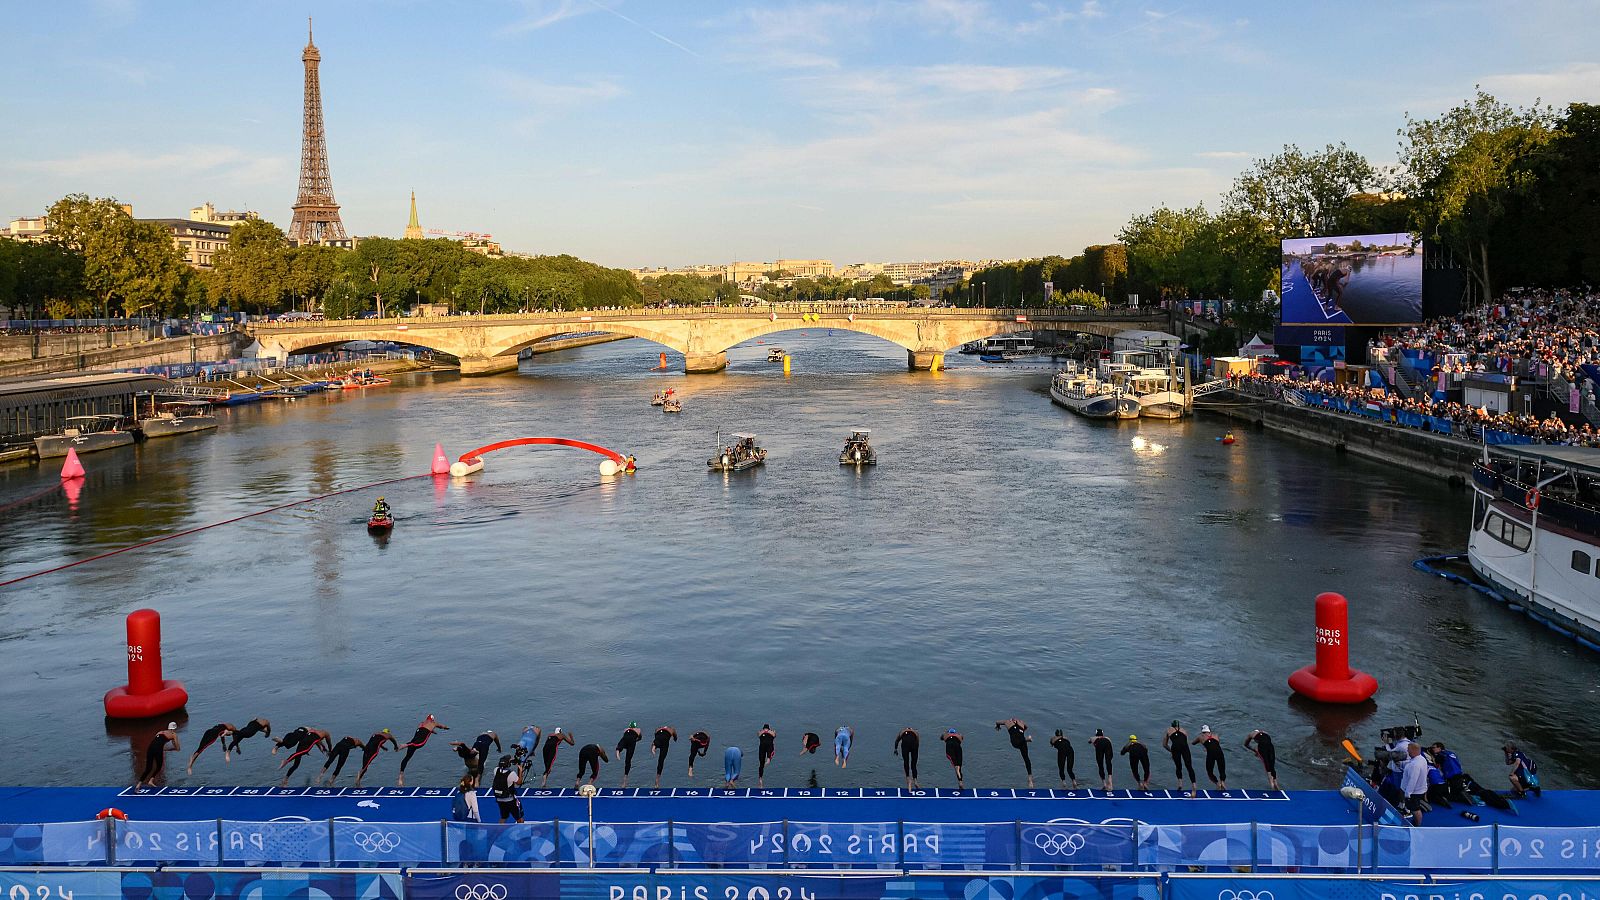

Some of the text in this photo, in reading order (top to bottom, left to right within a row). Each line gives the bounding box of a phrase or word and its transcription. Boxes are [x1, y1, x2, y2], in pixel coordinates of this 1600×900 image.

[127, 654, 143, 662] 24
[0, 884, 73, 900] 024
[724, 886, 815, 900] 2024
